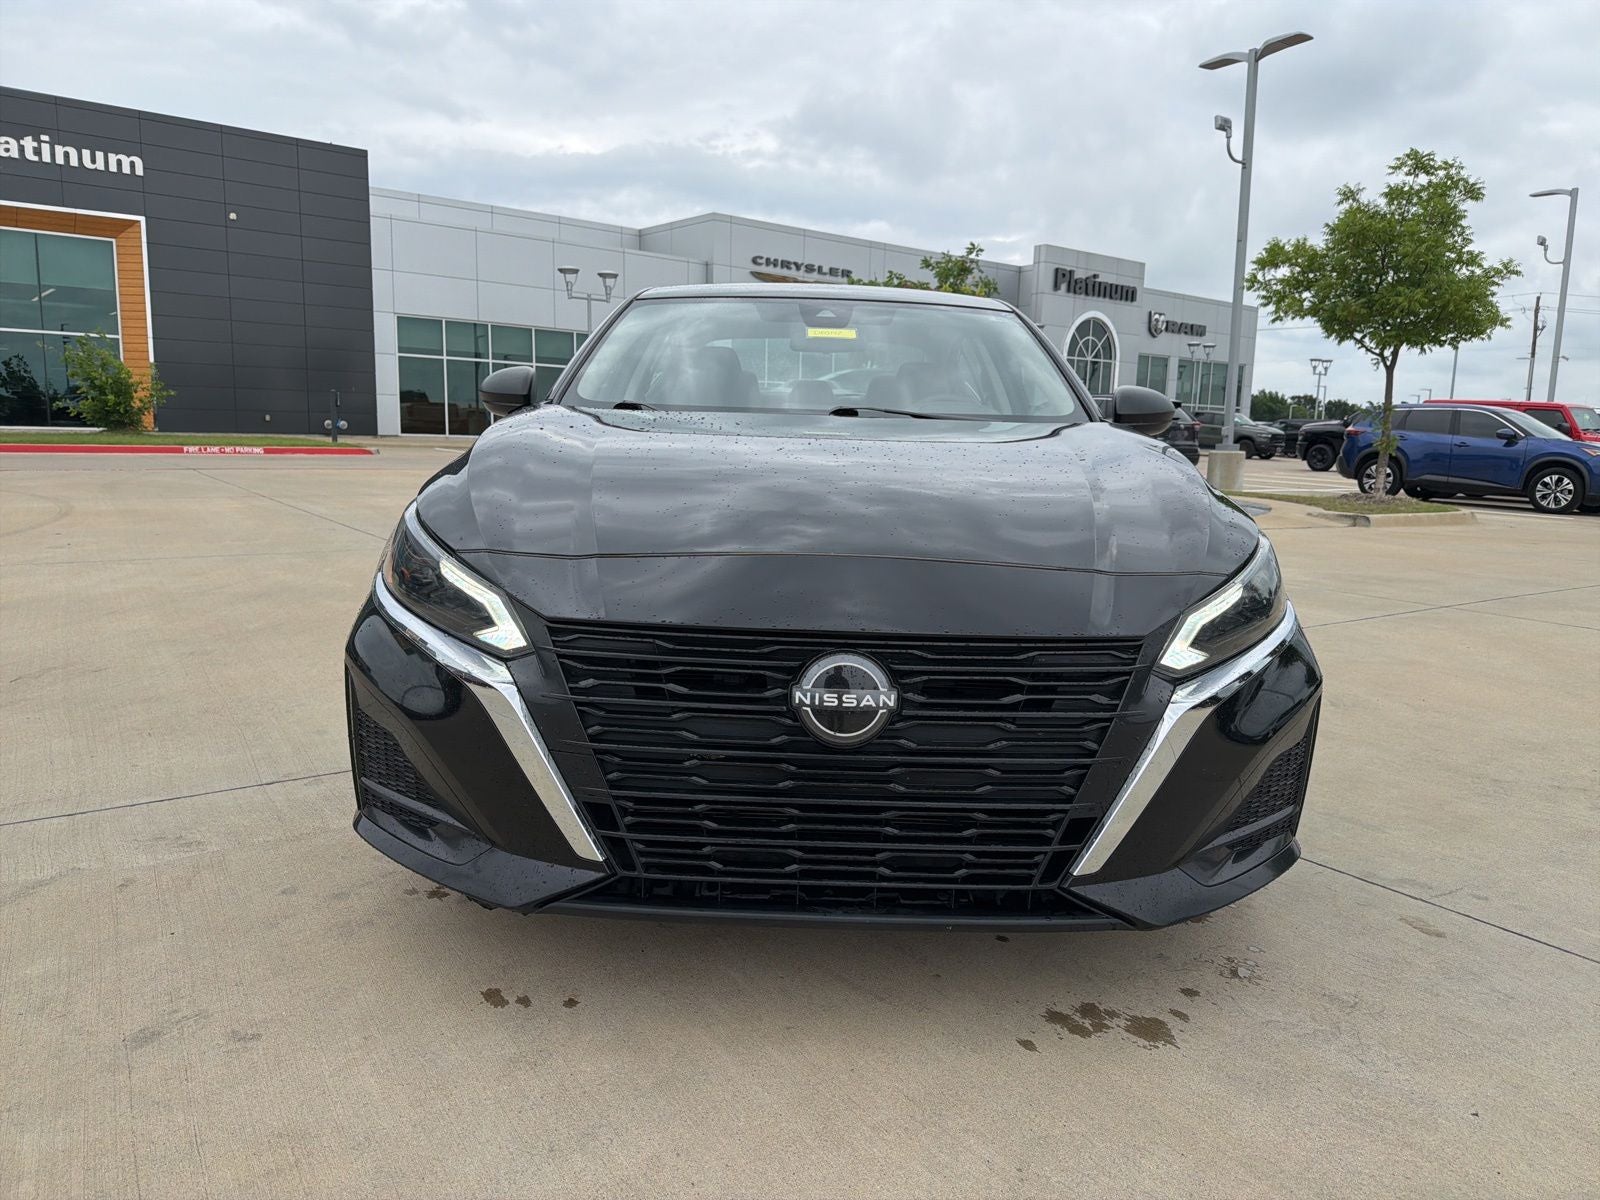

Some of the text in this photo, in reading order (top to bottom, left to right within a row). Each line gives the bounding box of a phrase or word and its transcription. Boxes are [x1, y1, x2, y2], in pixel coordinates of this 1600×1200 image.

[751, 255, 853, 278] CHRYSLER
[1053, 267, 1138, 303] Platinum
[1165, 320, 1207, 337] RAM
[183, 446, 199, 454] FIRE
[201, 446, 220, 454] LANE
[235, 446, 264, 454] PARKING
[795, 691, 895, 707] NISSAN
